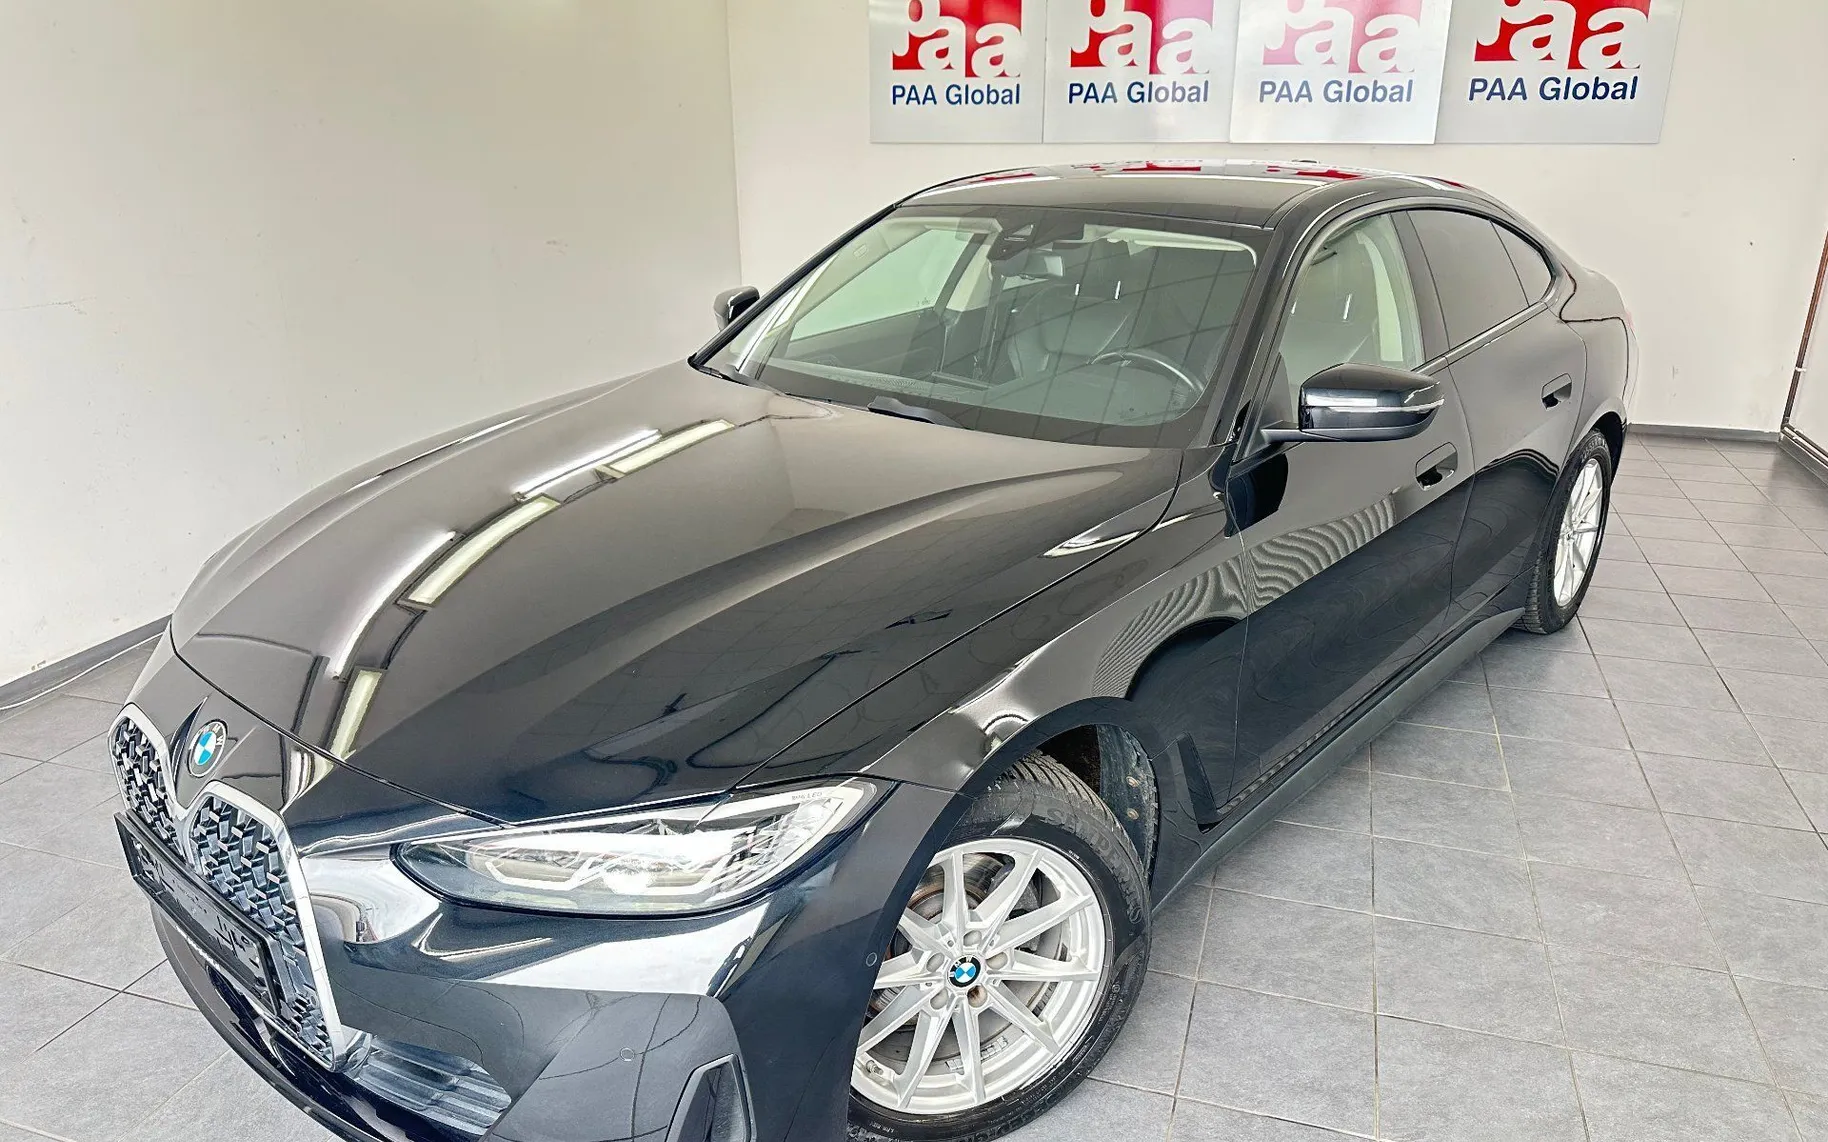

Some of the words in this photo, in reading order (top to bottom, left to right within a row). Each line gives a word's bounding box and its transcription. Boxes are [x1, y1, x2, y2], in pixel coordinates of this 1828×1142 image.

[892, 84, 937, 105] PAA
[945, 83, 1020, 105] Global
[1068, 82, 1118, 104] PAA
[1126, 80, 1209, 103] Global
[1259, 80, 1313, 103] PAA
[1323, 79, 1414, 103] Global
[1468, 77, 1528, 101] PAA
[1539, 75, 1639, 101] Global
